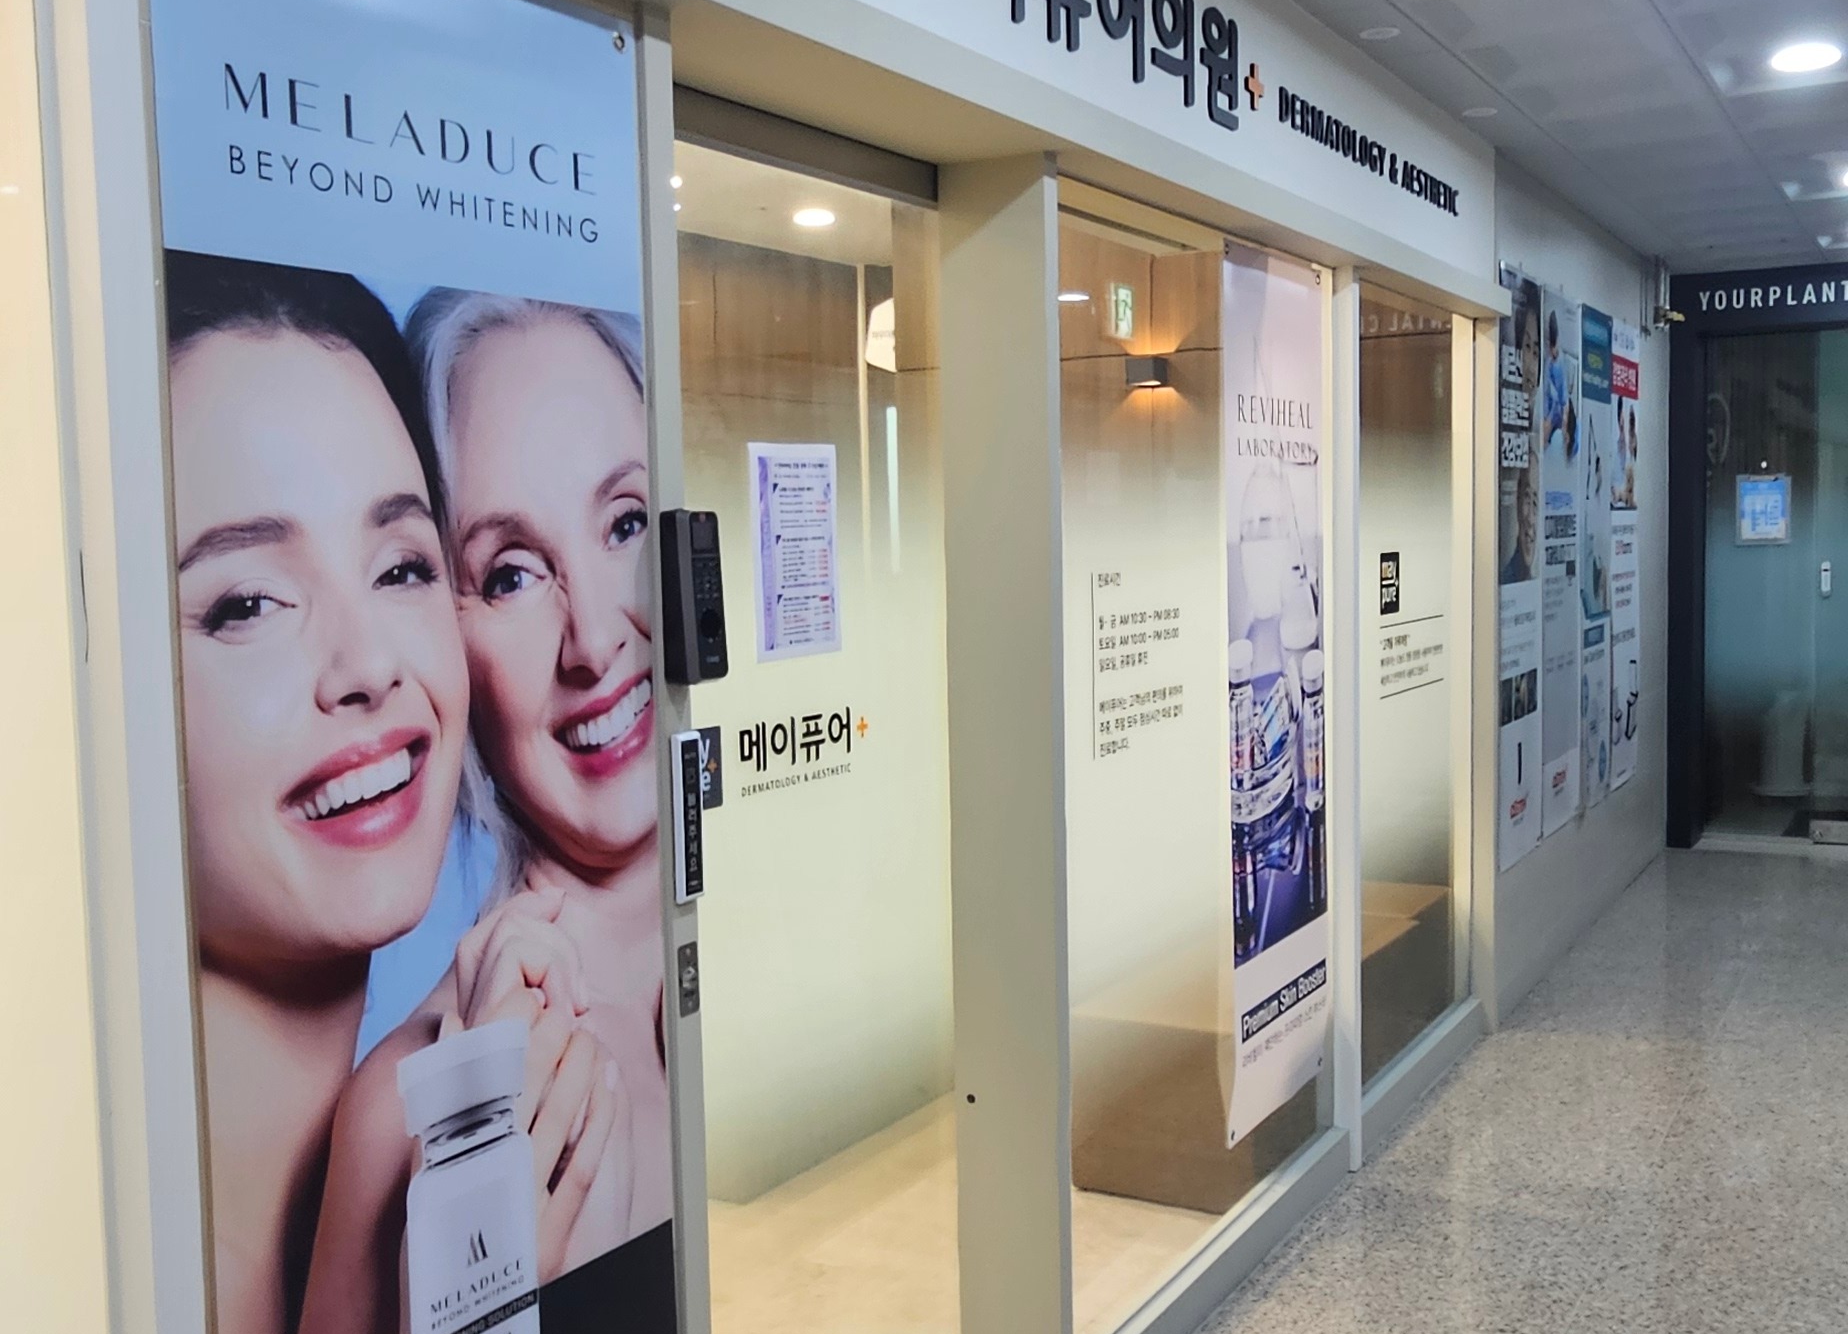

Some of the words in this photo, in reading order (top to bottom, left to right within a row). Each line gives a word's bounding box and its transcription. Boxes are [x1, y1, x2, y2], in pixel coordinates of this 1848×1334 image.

[223, 63, 598, 196] MELADUCE
[1278, 86, 1387, 177] DERMATOLOGY
[1389, 153, 1398, 184] &
[1401, 159, 1459, 217] AESTHETIC
[229, 145, 393, 205] BEYOND
[416, 183, 599, 244] WHITENING
[1699, 279, 1848, 311] YOURPLANT
[1238, 394, 1313, 429] REVIHEAL
[739, 706, 852, 772] 메이퓨어
[741, 774, 801, 798] DERMATOLOGY
[812, 762, 851, 781] AESTHETIC
[487, 1294, 535, 1326] SOLUTION
